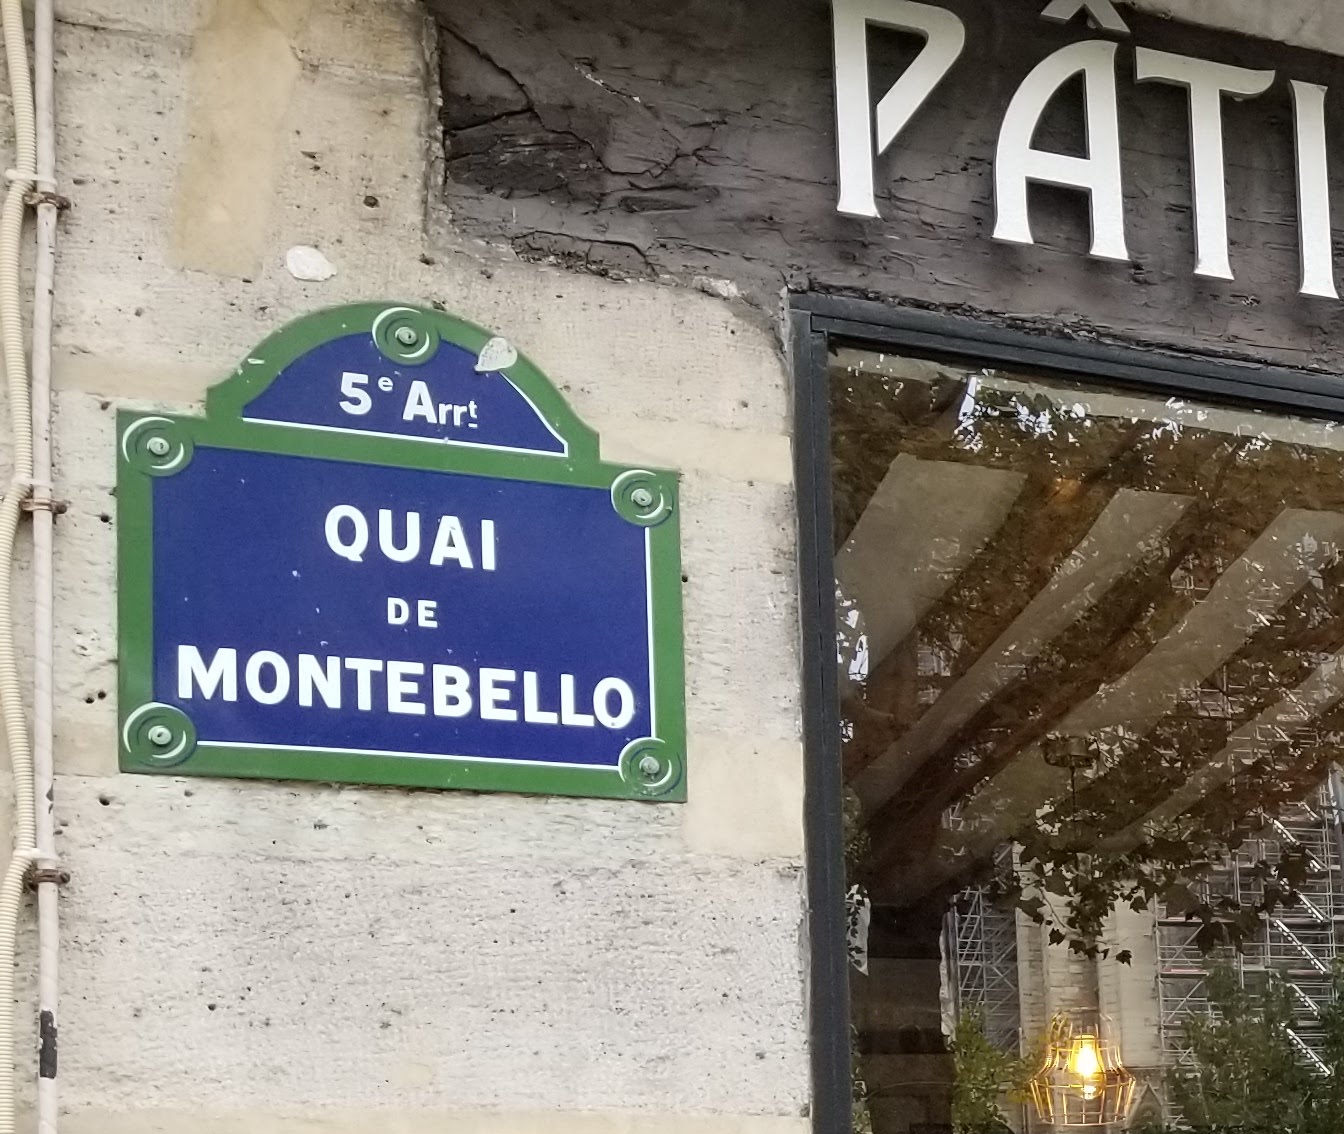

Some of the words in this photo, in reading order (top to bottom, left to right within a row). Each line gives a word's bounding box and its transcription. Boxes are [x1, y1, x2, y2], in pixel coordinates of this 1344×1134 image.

[324, 504, 497, 572] QUAI
[387, 597, 438, 629] DE
[177, 644, 635, 730] MONTEBELLO
